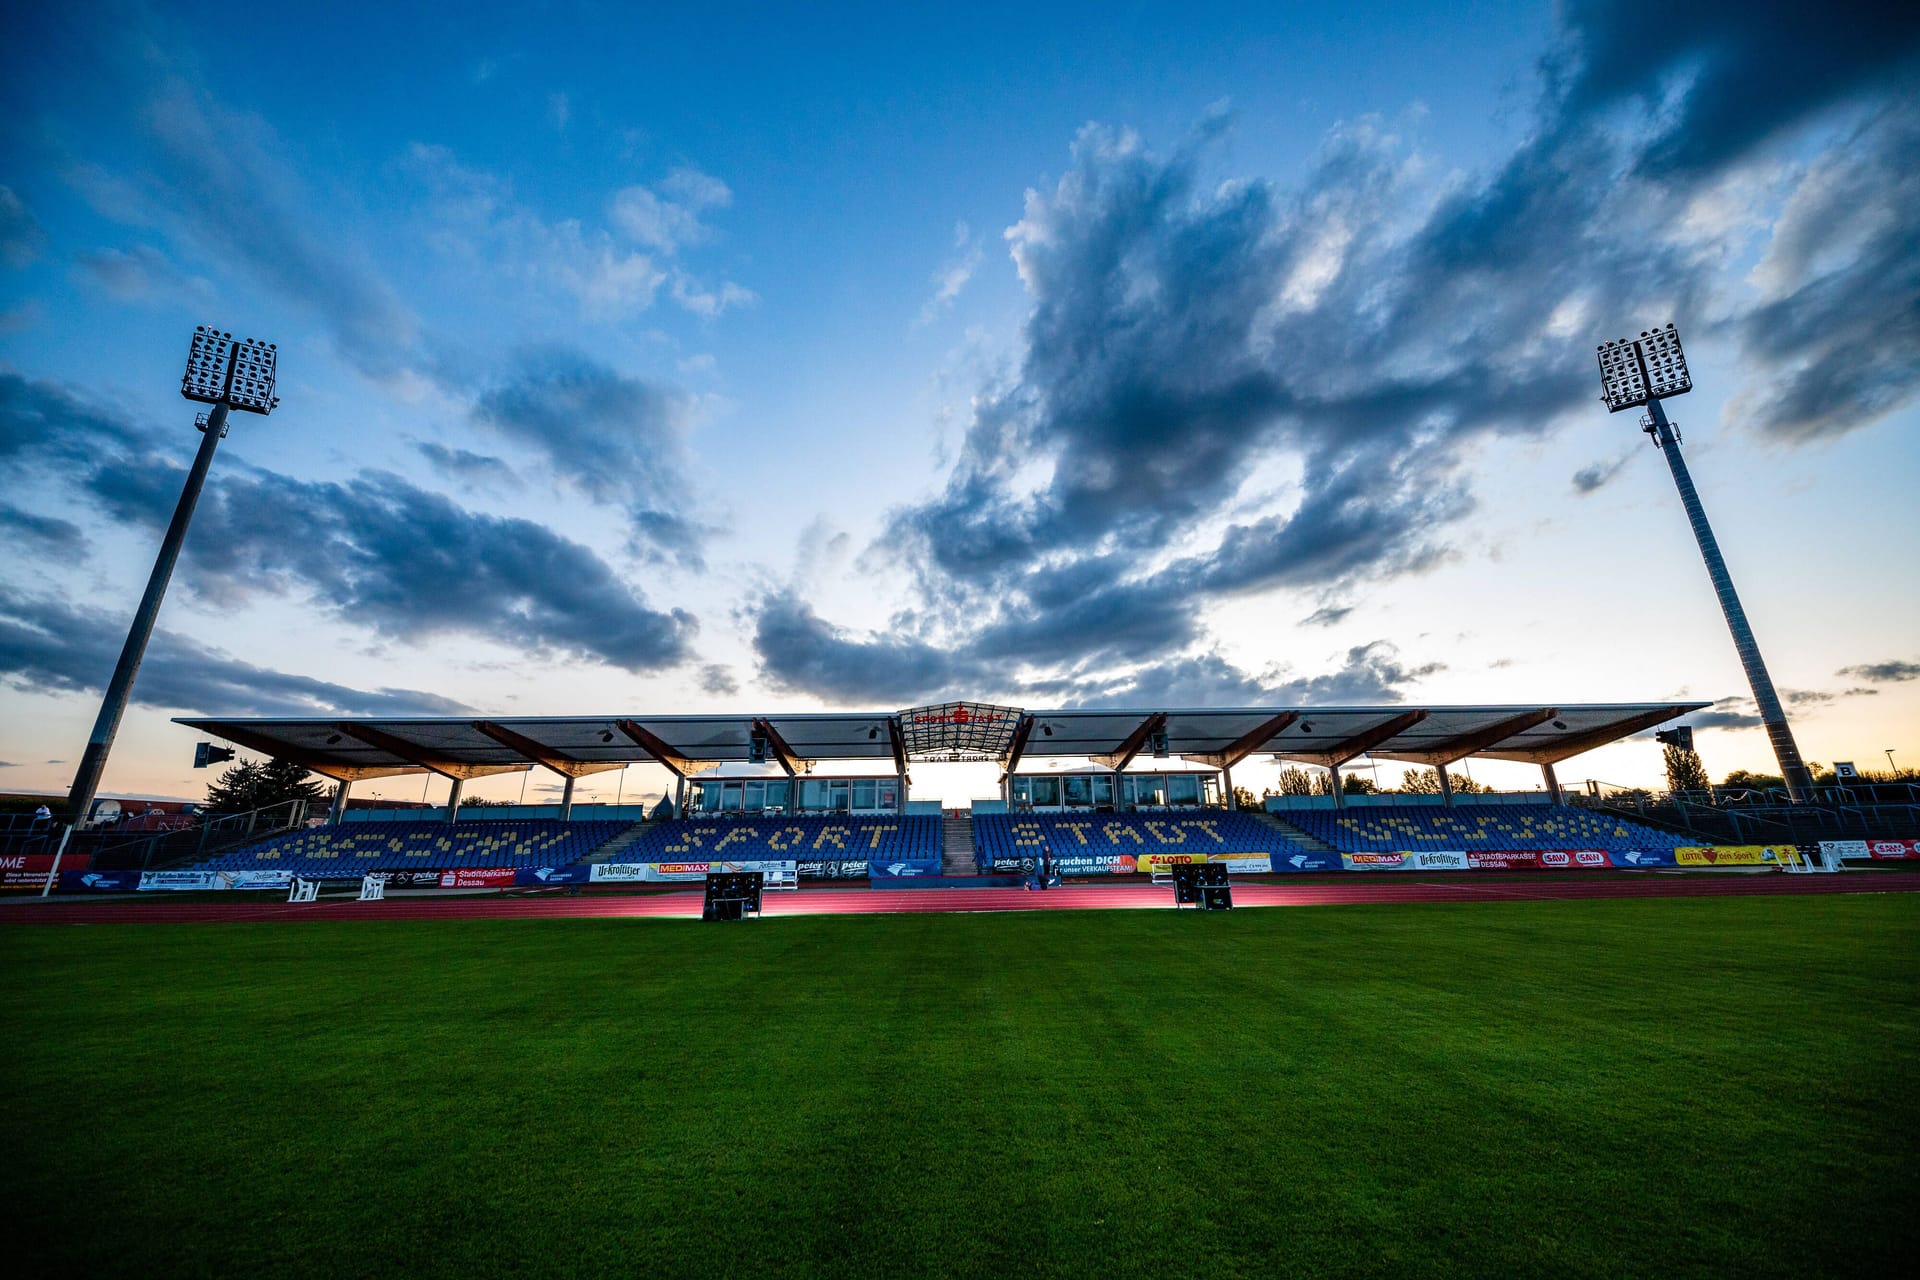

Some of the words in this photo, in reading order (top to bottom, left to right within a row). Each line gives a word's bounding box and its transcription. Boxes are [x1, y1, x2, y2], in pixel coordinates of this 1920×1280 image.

[1840, 767, 1852, 776] B
[664, 825, 898, 852] SPORT
[1059, 857, 1093, 866] suchen
[1095, 856, 1120, 865] DICH
[1162, 855, 1192, 864] LOTTO
[1546, 854, 1566, 862] SAW
[1580, 853, 1600, 862] SAW
[798, 861, 823, 870] peter
[841, 860, 868, 870] peter
[994, 858, 1019, 867] peter
[660, 864, 709, 873] MEDIMAX
[412, 871, 440, 880] peter
